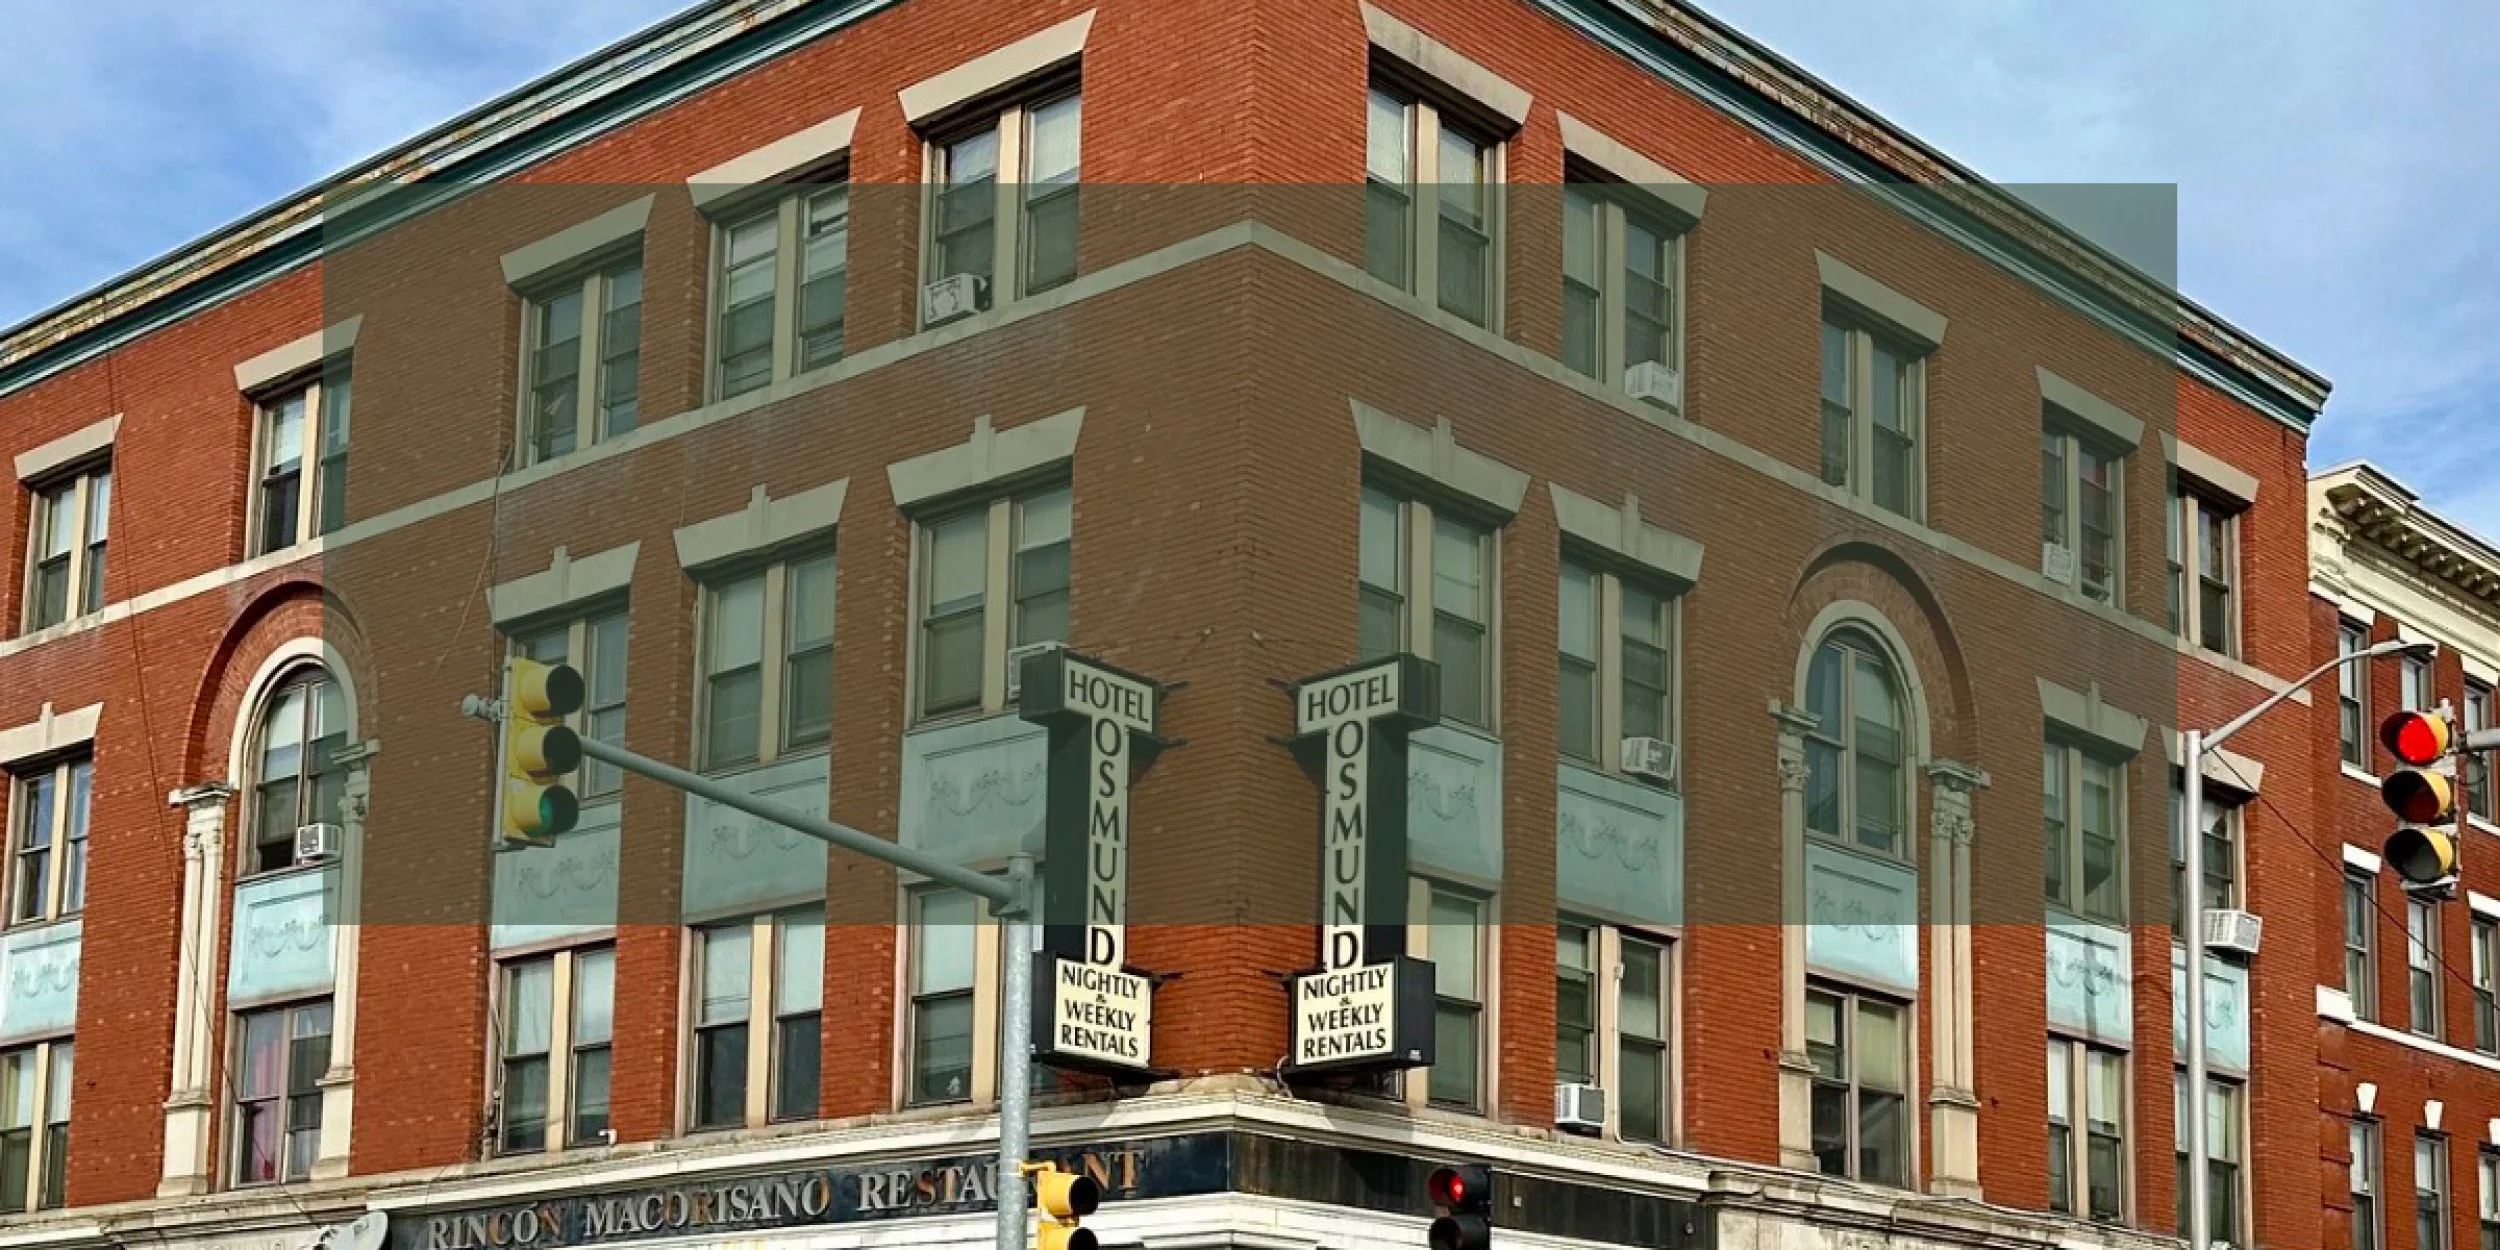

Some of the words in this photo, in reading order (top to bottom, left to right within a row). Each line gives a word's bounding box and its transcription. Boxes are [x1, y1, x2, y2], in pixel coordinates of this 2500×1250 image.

[1069, 669, 1149, 723] HOTEL
[1307, 673, 1395, 721] HOTEL
[1090, 718, 1121, 965] OSMUND
[1331, 720, 1364, 969] OSMUND
[1062, 963, 1140, 999] NIGHTLY
[1303, 968, 1388, 1000] NIGHTLY
[1064, 998, 1136, 1031] WEEKLY
[1096, 994, 1107, 1005] &
[1339, 996, 1352, 1007] &
[1308, 1002, 1384, 1033] WEEKLY
[1062, 1023, 1138, 1058] RENTALS
[1303, 1028, 1386, 1059] RENTALS
[427, 1202, 563, 1250] RINCÓN
[584, 1172, 831, 1236] MACORISANO
